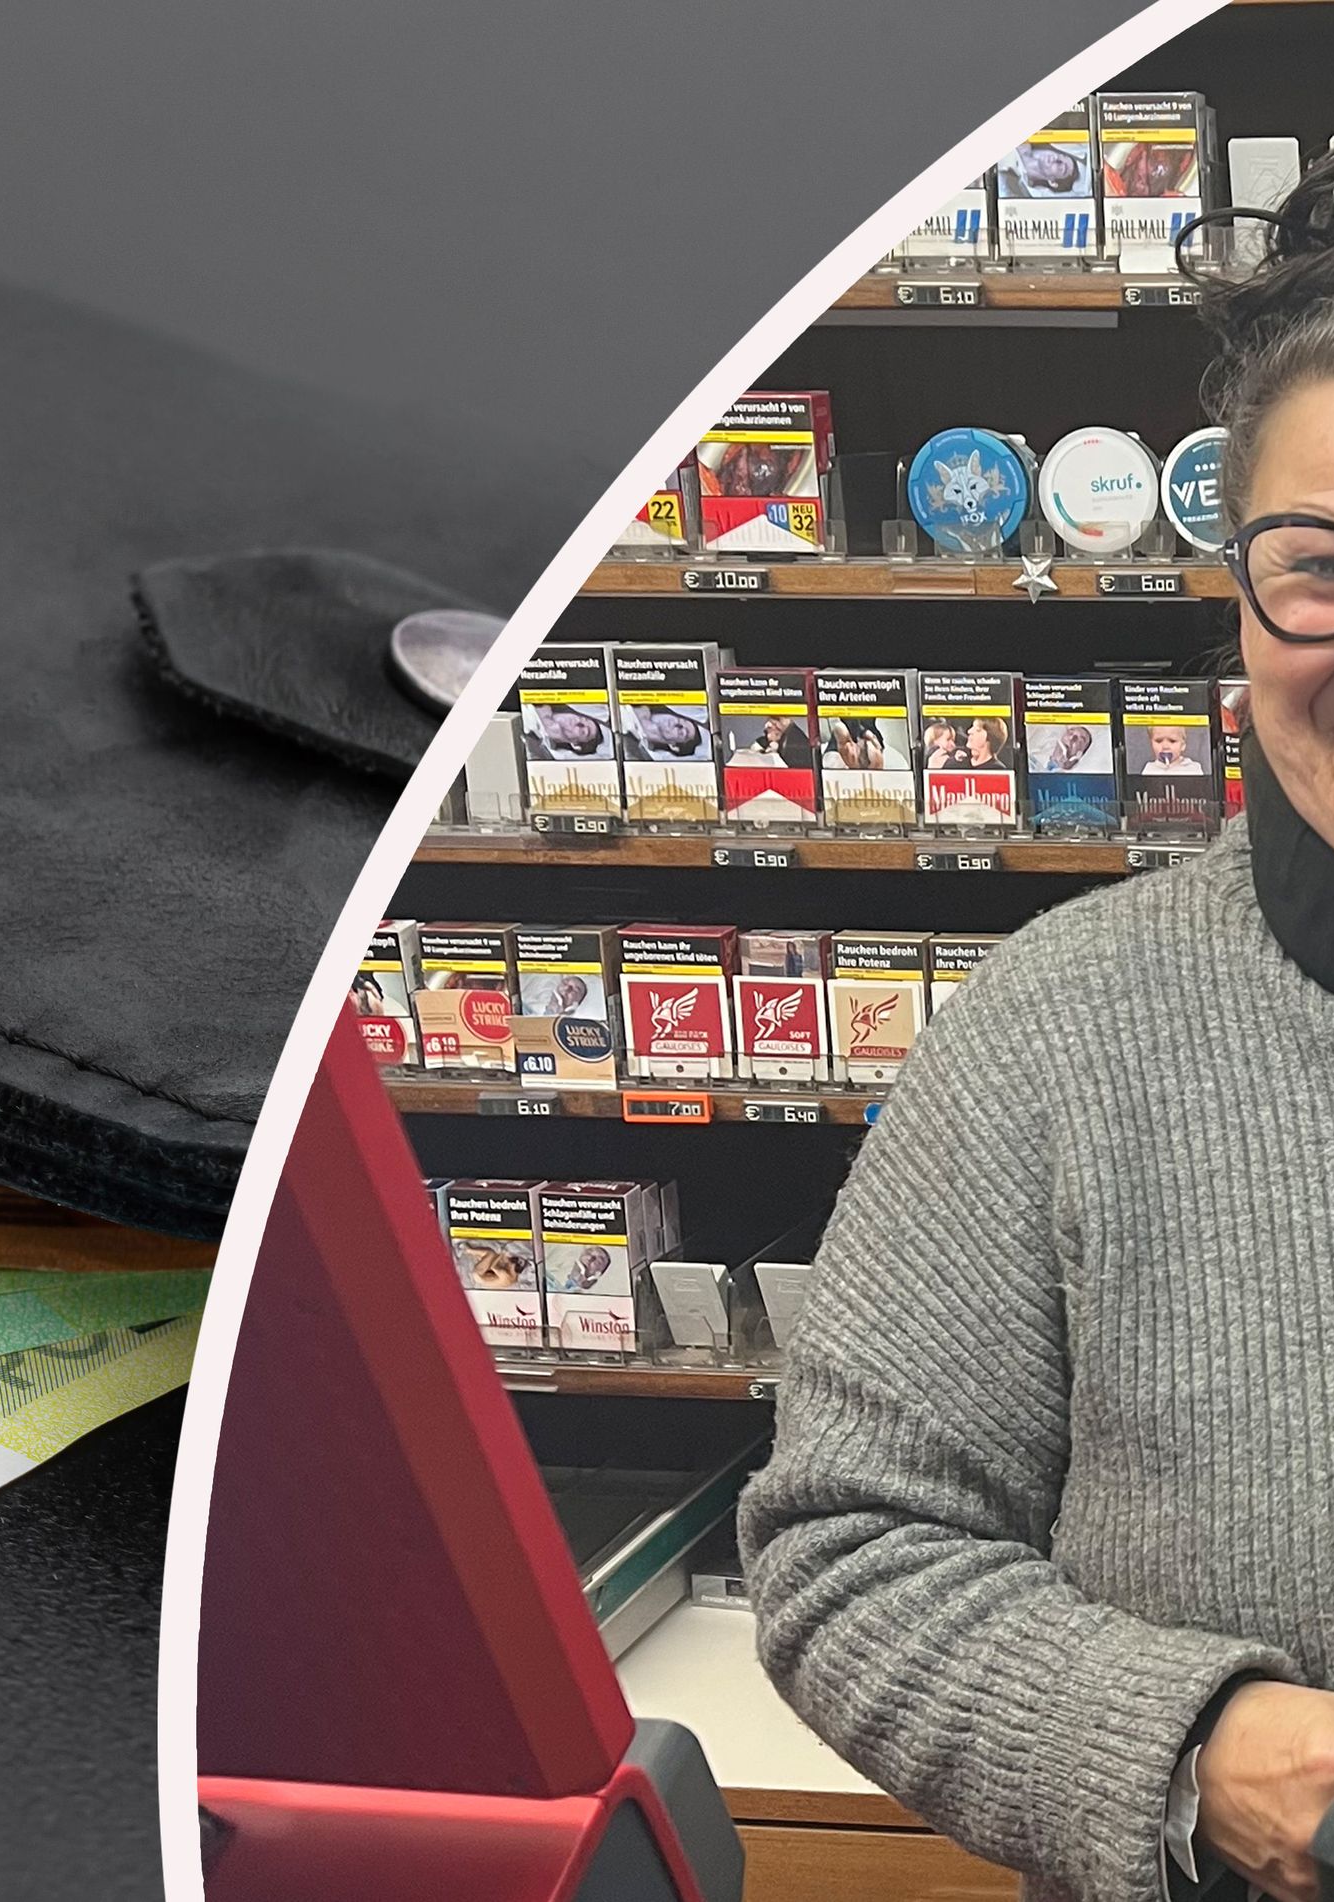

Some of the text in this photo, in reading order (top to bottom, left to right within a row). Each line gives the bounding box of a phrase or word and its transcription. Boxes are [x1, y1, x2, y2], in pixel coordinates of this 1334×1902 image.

[1005, 220, 1061, 240] PALL MALL
[1111, 219, 1167, 239] PALL MALL
[651, 500, 675, 520] 22
[792, 504, 813, 514] NEU
[793, 514, 814, 531] 32
[715, 572, 759, 589] 10.00
[1141, 574, 1176, 591] 6.00
[617, 659, 698, 670] Rauchen verursacht
[818, 678, 901, 692] Rauchen verstopft
[819, 691, 877, 702] Ihre Arterien
[825, 773, 913, 808] Marlboro
[932, 778, 1010, 812] Marlboro
[1135, 784, 1207, 814] Marlboro
[622, 939, 657, 951] Rauchen
[837, 943, 918, 958] Rauchen bedroht
[935, 945, 975, 958] Rauchen
[837, 956, 891, 968] Ihre Potenz
[935, 957, 955, 969] Ihre
[471, 1001, 506, 1016] LUCKY
[472, 1014, 509, 1028] STRIKE
[566, 1024, 601, 1038] LUCKY
[789, 1031, 811, 1040] SOFT
[566, 1036, 607, 1049] STRIKE
[654, 1041, 703, 1051] GAULOISES
[758, 1041, 809, 1052] GAULOISES
[853, 1047, 903, 1057] GAULOISES
[668, 1101, 702, 1116] 7.00
[784, 1106, 817, 1123] 6.40
[449, 1198, 528, 1211] Rauchen bedroht
[487, 1311, 537, 1331] Winston
[579, 1315, 630, 1336] Winston
